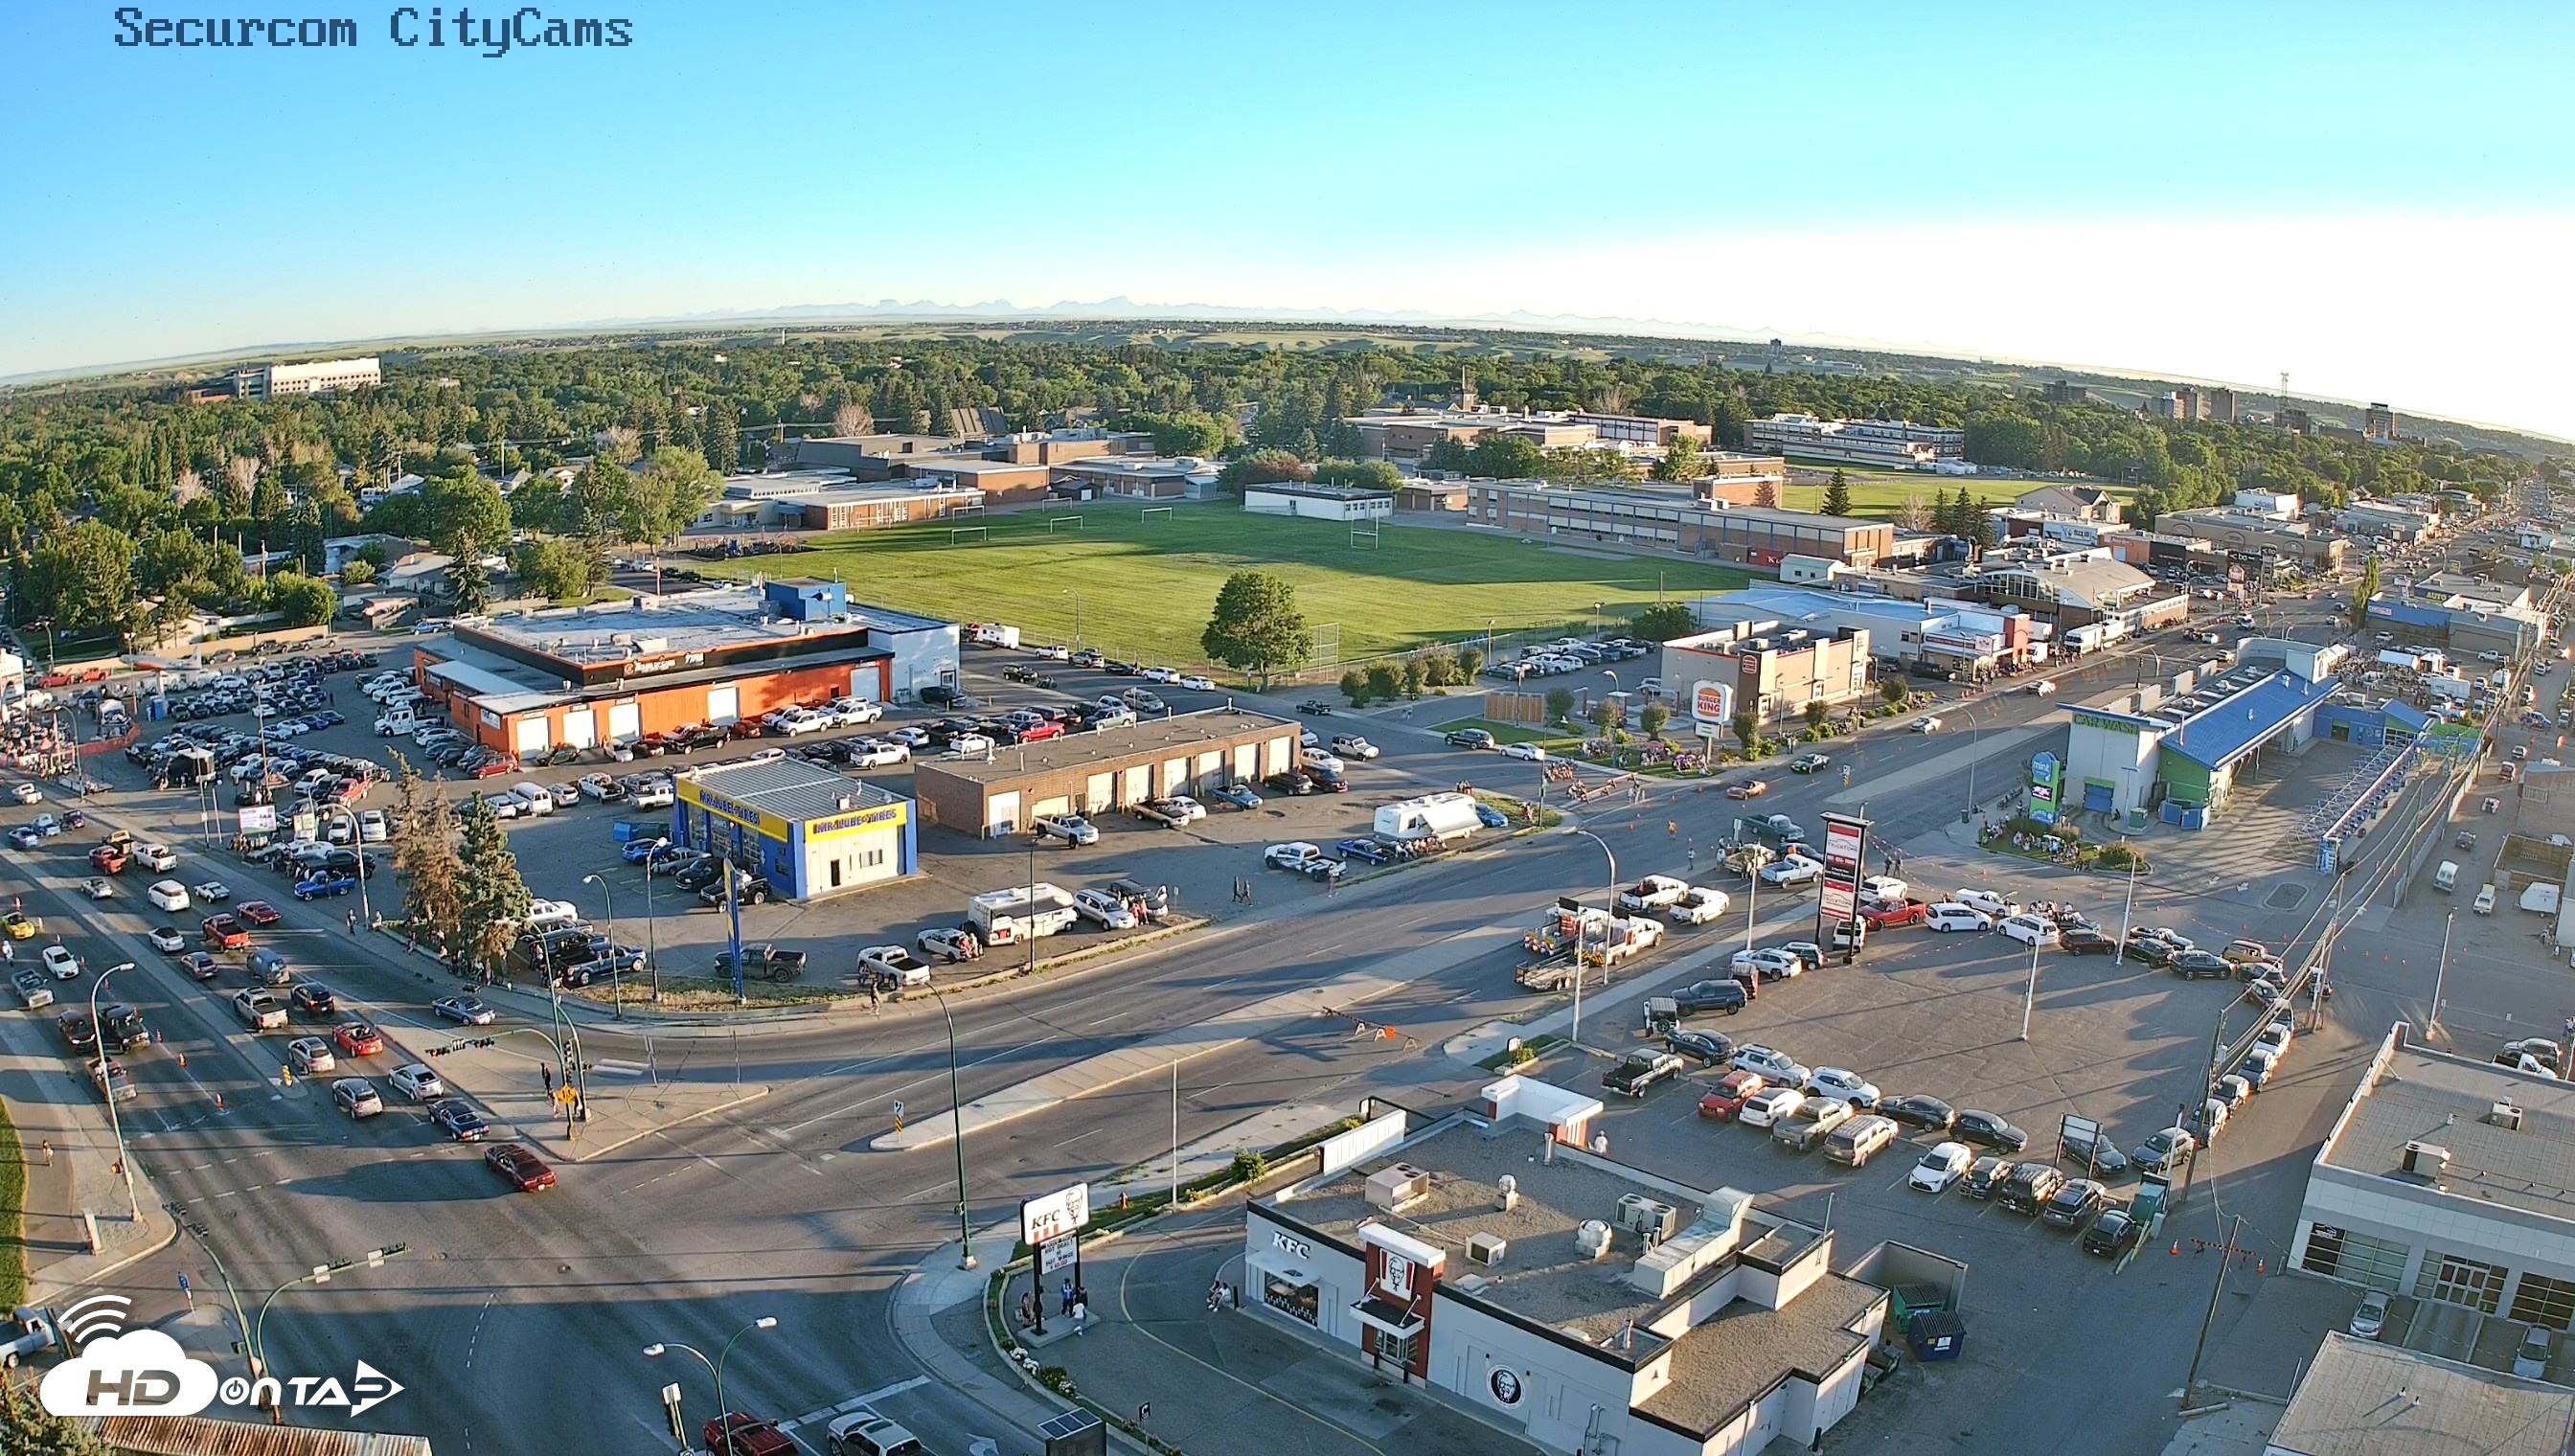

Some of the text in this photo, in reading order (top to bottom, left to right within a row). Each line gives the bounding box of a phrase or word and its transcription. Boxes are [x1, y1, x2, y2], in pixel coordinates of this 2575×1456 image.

[1698, 694, 1721, 705] BURGER
[1698, 700, 1720, 713] KING
[2074, 713, 2138, 735] CAR WASH
[1031, 1209, 1061, 1230] KFC
[1271, 1231, 1310, 1261] KFC
